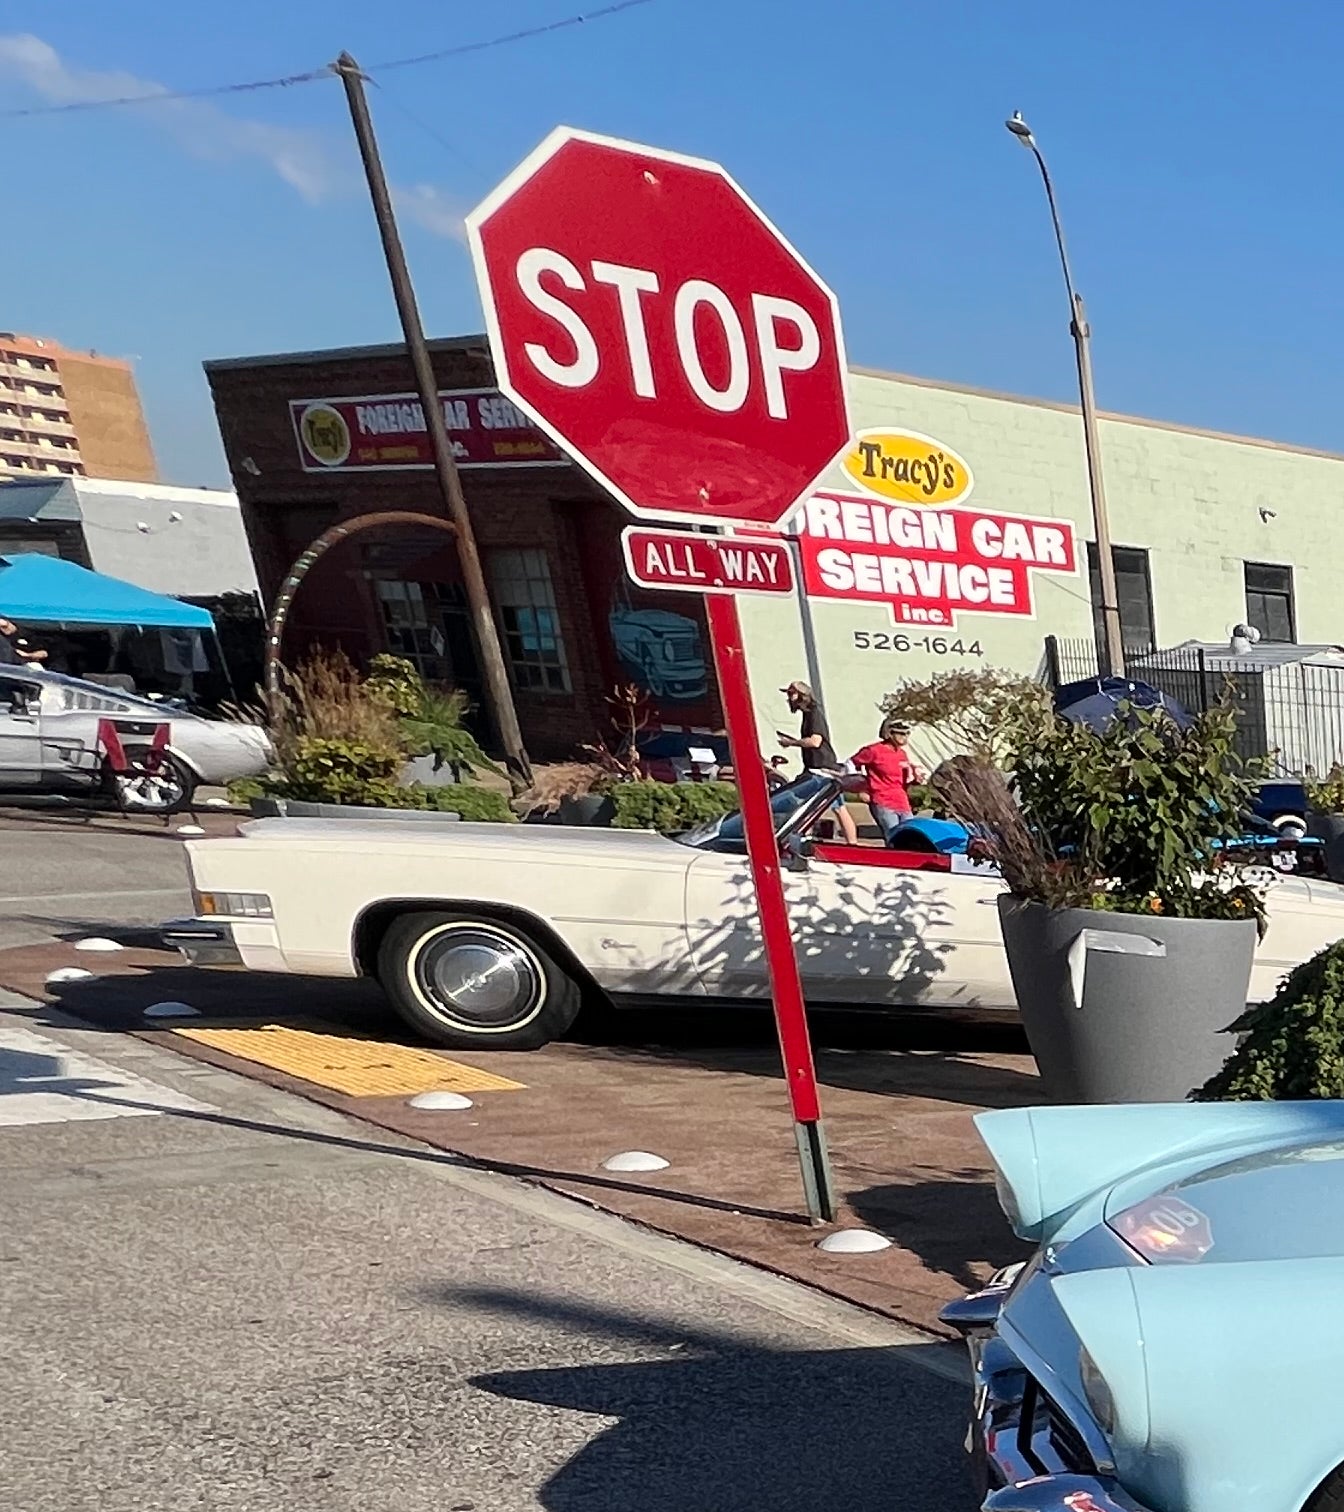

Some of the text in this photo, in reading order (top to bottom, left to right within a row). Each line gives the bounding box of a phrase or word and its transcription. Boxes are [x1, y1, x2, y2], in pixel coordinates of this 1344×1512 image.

[516, 247, 821, 421] STOP
[443, 400, 470, 430] AR
[859, 441, 954, 495] Tracy's
[796, 496, 1067, 565] REIGN CAR
[645, 542, 778, 584] ALL WAY
[816, 548, 1016, 605] SERVICE
[901, 603, 949, 624] inc.
[854, 631, 984, 657] 526-1644
